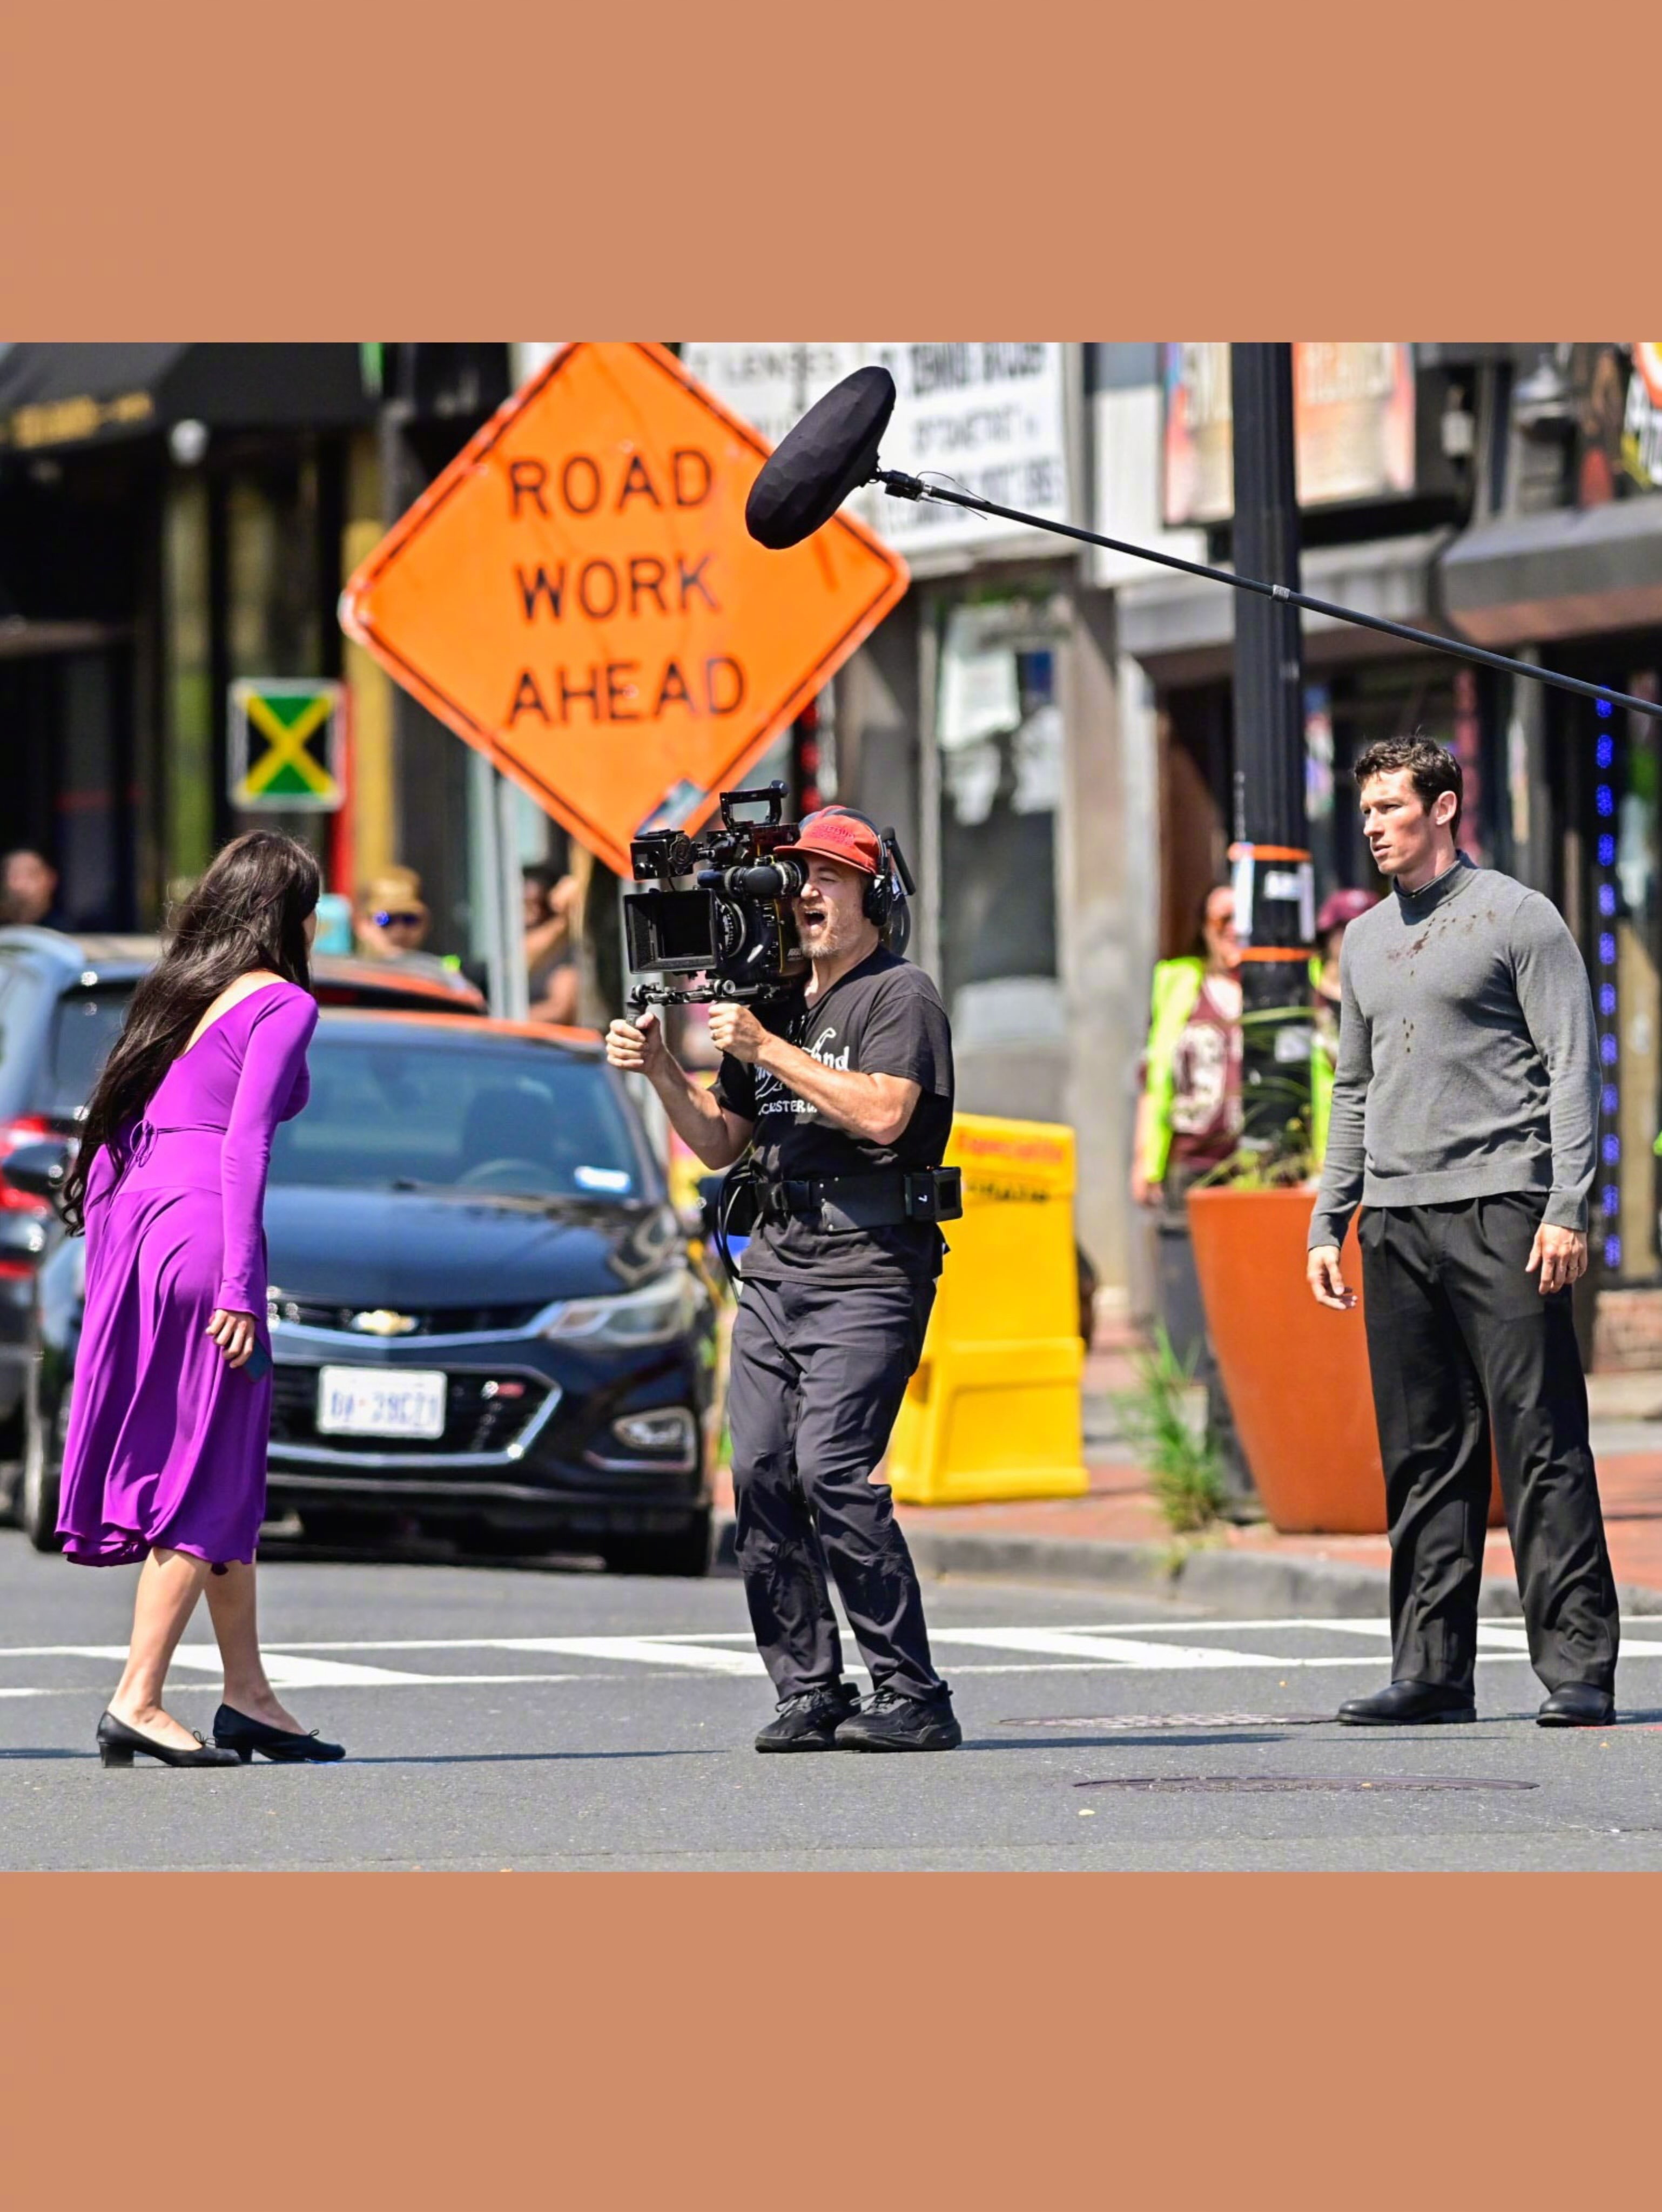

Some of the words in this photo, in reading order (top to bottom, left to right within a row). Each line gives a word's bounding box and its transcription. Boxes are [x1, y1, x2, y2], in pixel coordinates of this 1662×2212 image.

[509, 448, 713, 517] ROAD
[514, 554, 722, 622] WORK
[507, 655, 745, 727] AHEAD
